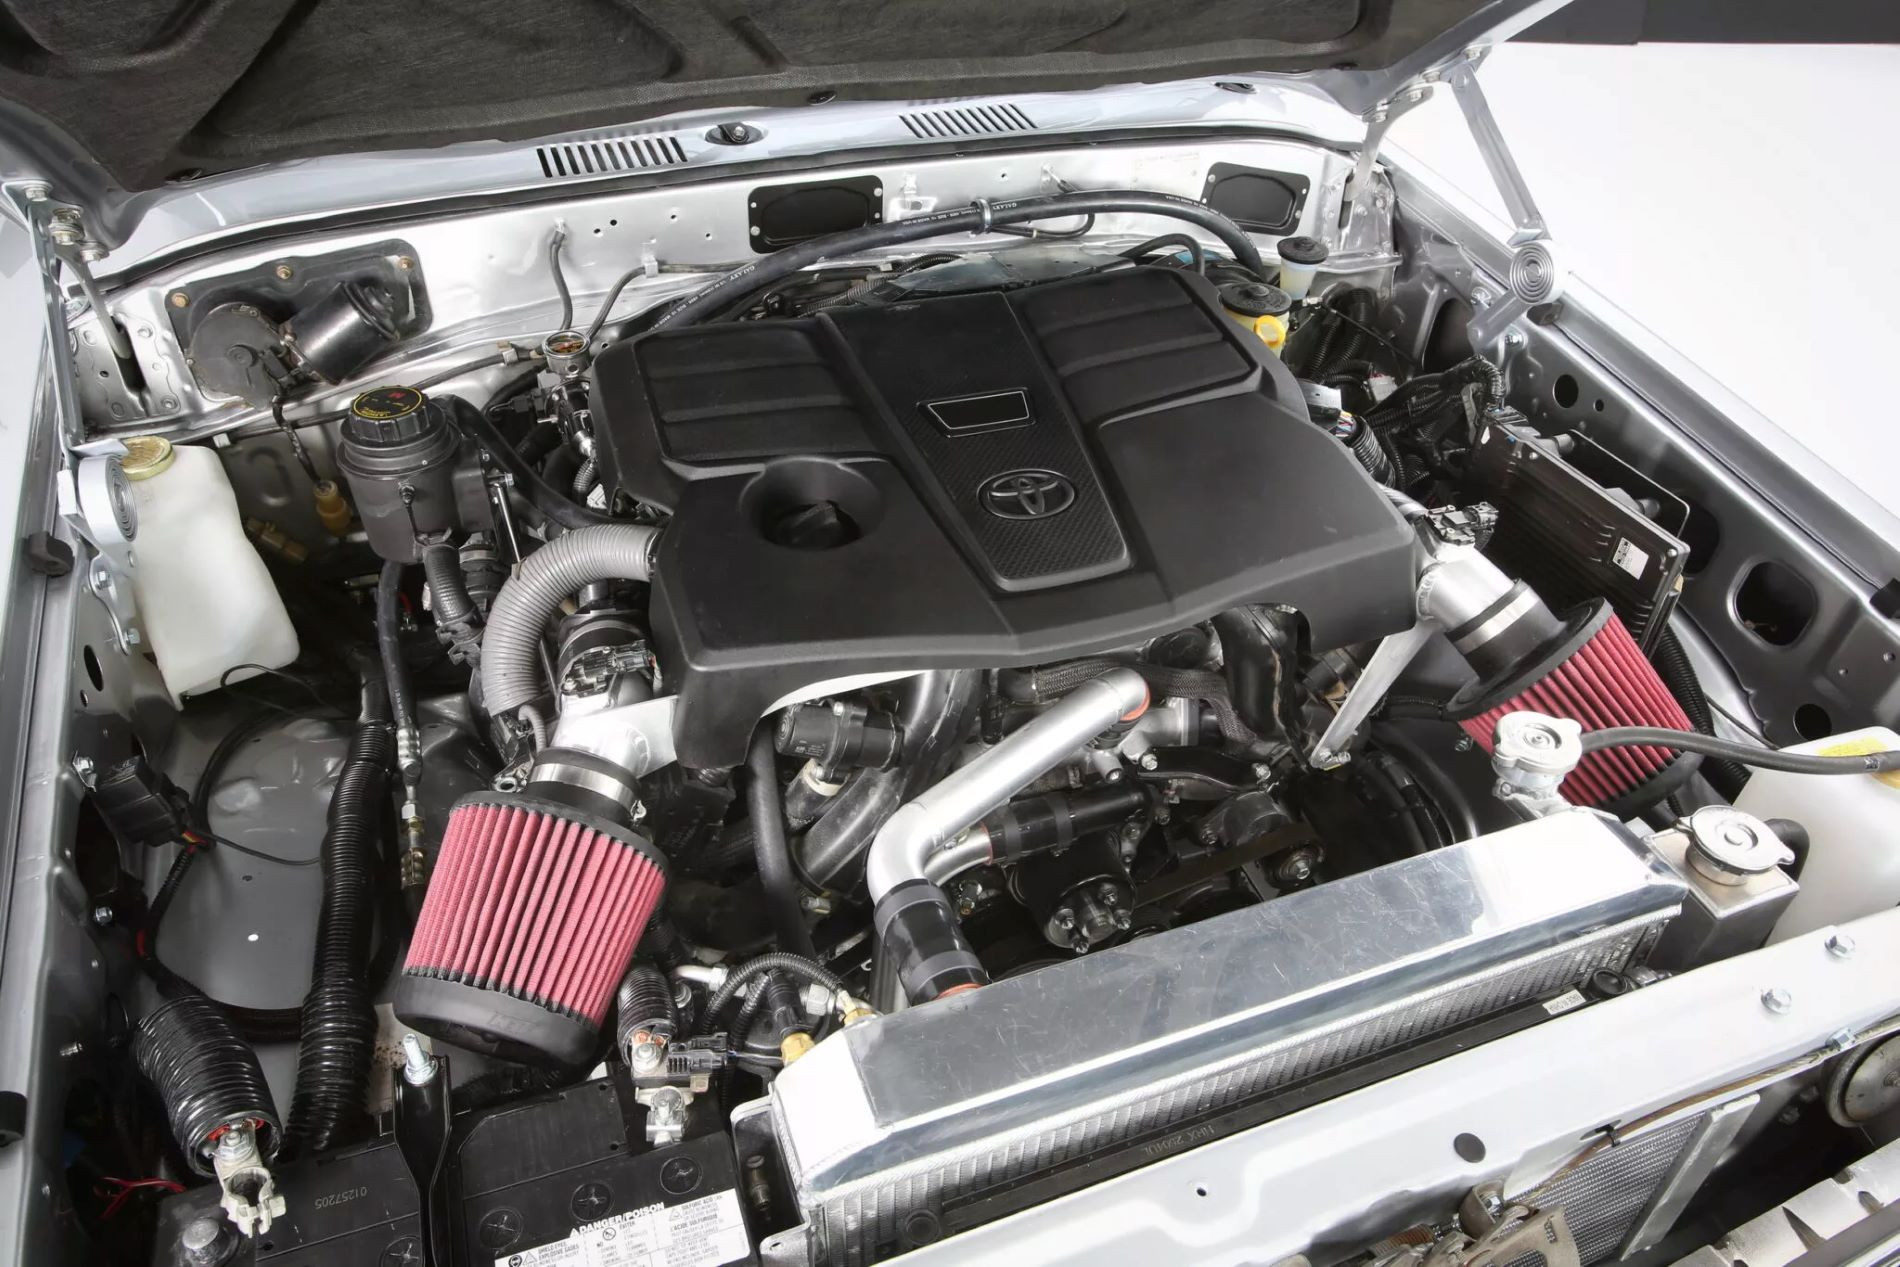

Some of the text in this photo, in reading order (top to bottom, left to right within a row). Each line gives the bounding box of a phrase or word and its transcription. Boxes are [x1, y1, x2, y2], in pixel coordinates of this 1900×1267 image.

[729, 265, 755, 281] GALAXY
[315, 1186, 368, 1210] 01257205
[579, 1202, 665, 1235] DANGER/POISON
